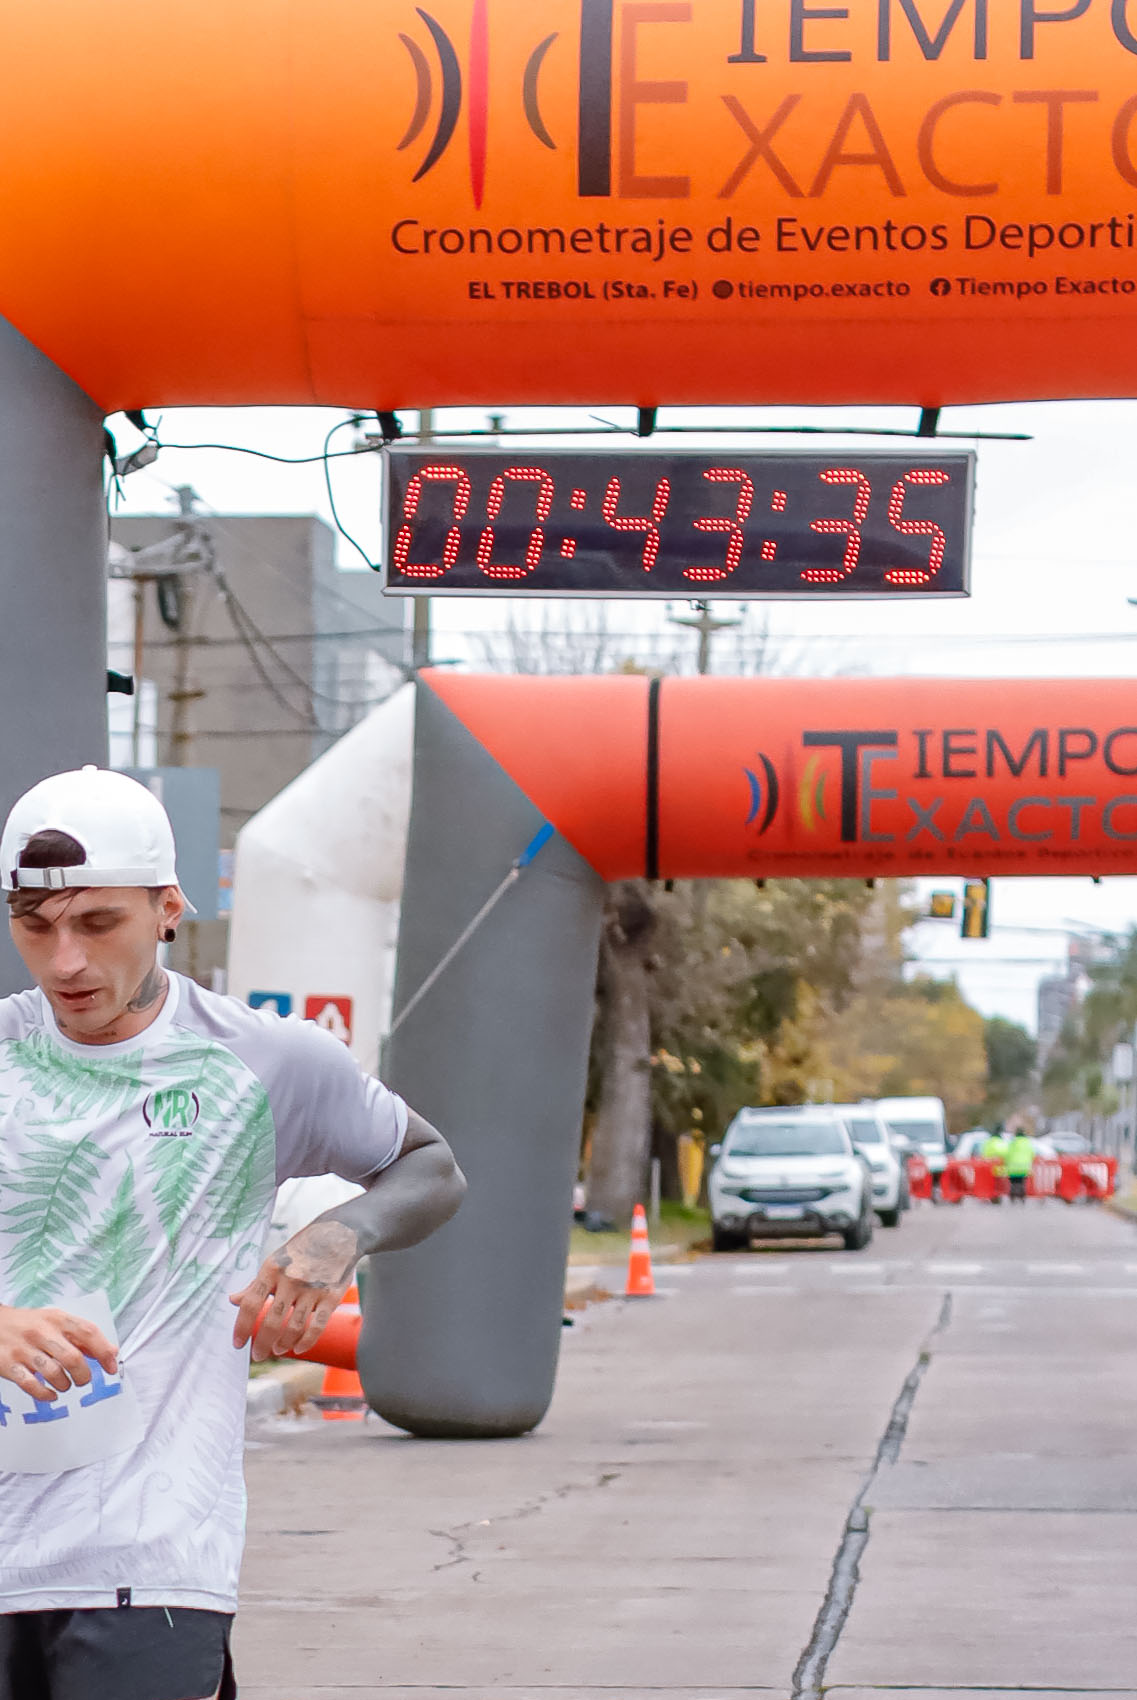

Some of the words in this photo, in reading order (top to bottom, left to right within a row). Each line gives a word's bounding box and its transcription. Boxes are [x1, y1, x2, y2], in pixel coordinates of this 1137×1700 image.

[620, 0, 1137, 198] EXACT
[391, 219, 693, 262] Cronometraje
[707, 217, 761, 252] de
[776, 217, 949, 251] Eventos
[964, 213, 1137, 258] Deporti
[468, 282, 494, 299] EL
[501, 281, 595, 300] TREBOL
[602, 280, 657, 301] (Sta.
[664, 279, 699, 301] Fe)
[738, 279, 911, 301] tiempo.exacto
[956, 277, 1048, 300] Tiempo
[1055, 276, 1136, 298] Exacto
[393, 464, 951, 585] 00:43:35
